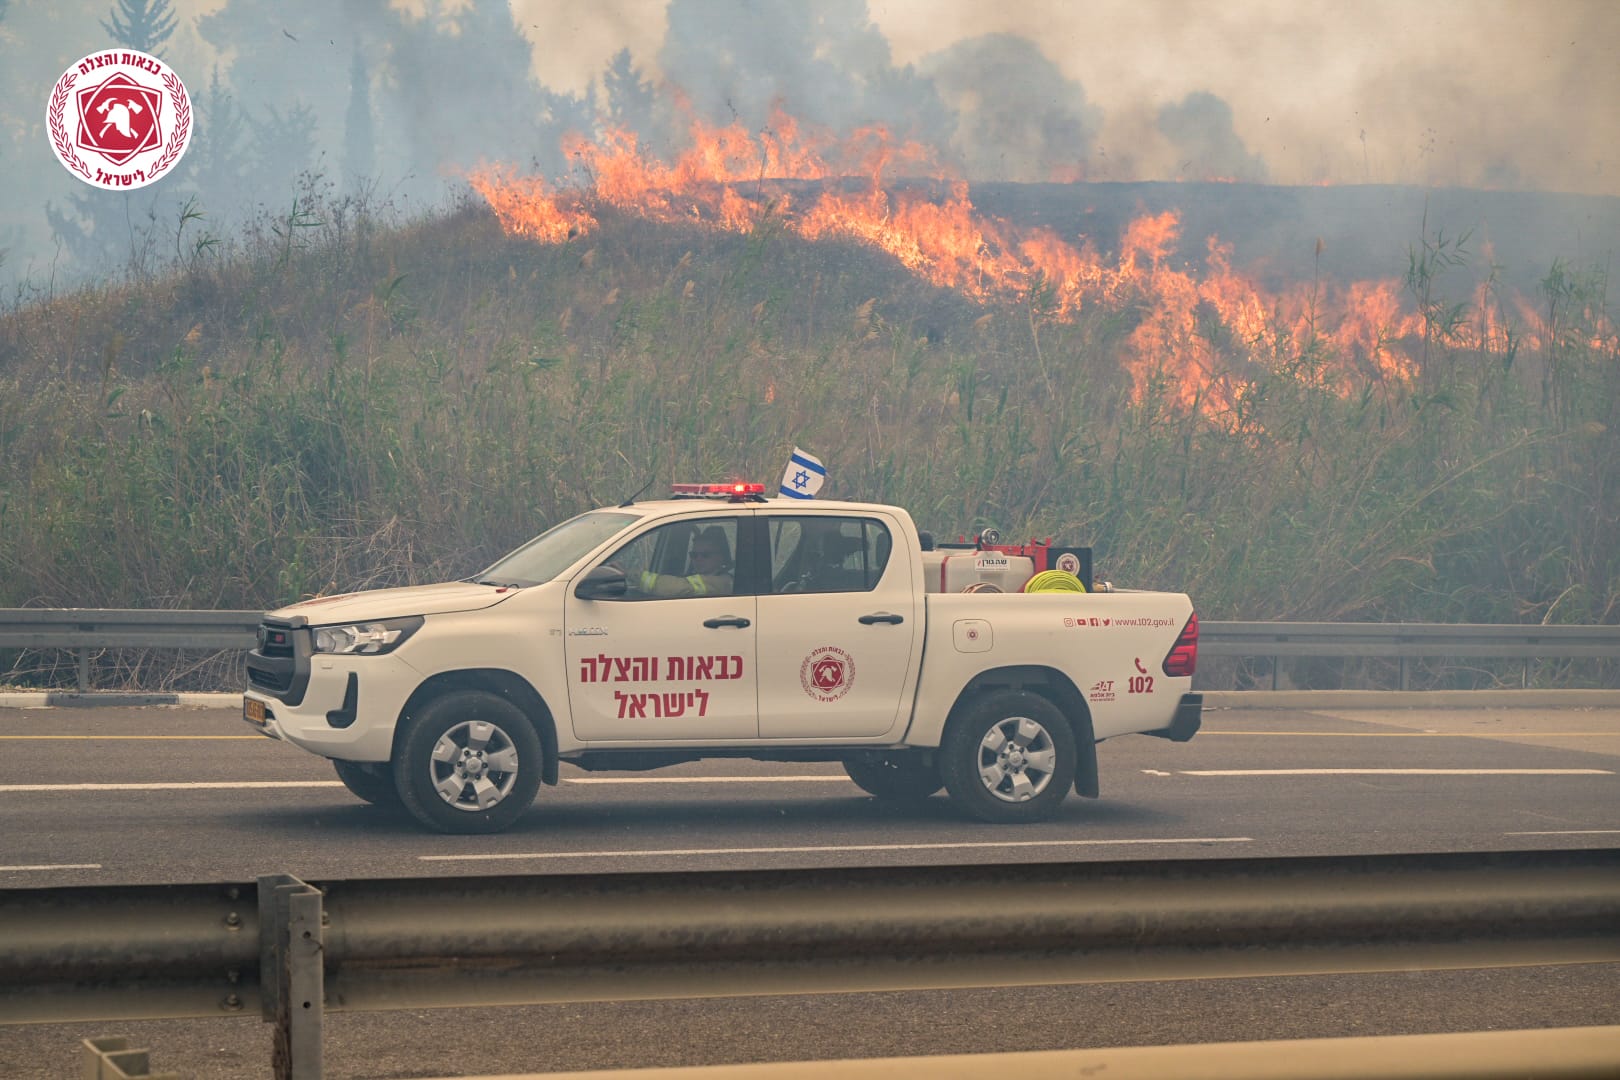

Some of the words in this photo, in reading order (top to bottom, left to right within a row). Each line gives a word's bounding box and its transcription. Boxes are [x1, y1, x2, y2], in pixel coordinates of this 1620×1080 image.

[1115, 618, 1174, 628] www.102.gov.il
[580, 653, 659, 683] והצלה
[666, 655, 743, 681] כבאות
[1128, 676, 1154, 693] 102
[614, 688, 709, 719] לישראל
